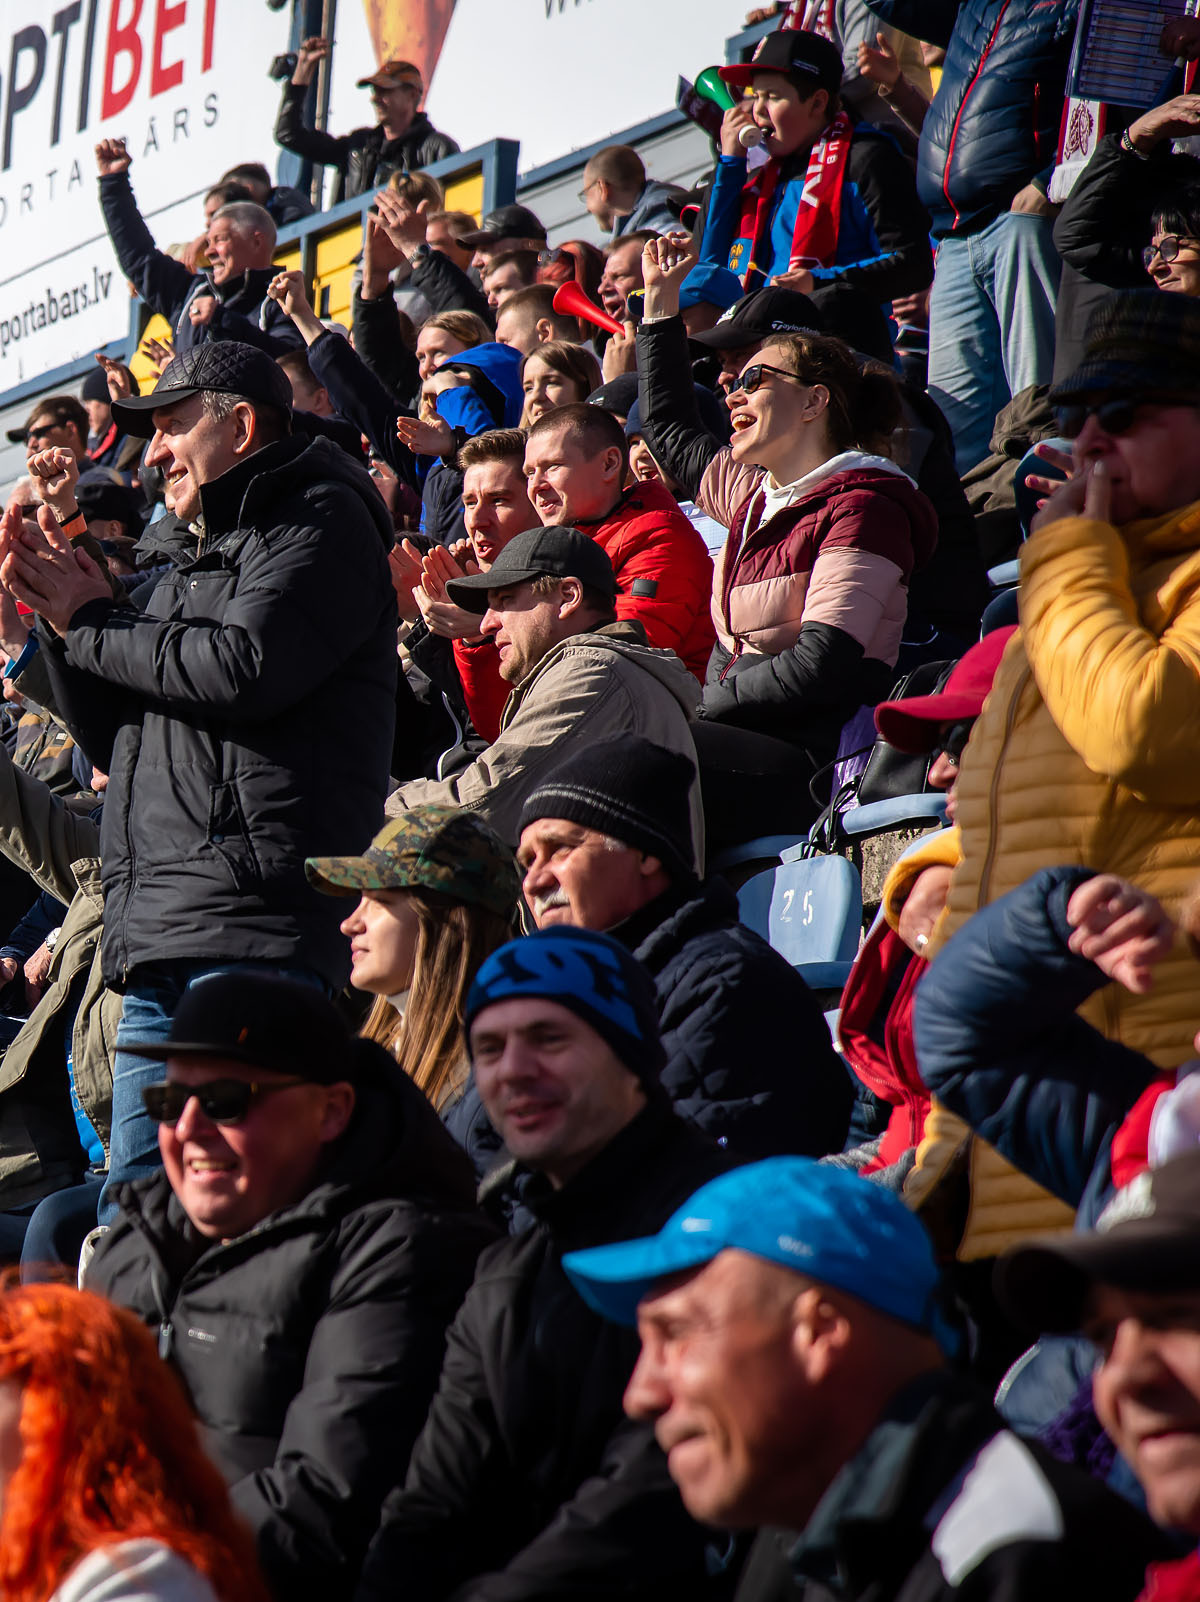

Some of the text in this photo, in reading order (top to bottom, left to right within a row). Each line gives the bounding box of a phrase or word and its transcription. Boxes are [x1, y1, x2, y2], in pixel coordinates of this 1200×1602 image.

[118, 94, 218, 157] ĀRS
[826, 121, 846, 165] CLUB
[801, 134, 828, 209] TIV
[780, 889, 813, 926] 25
